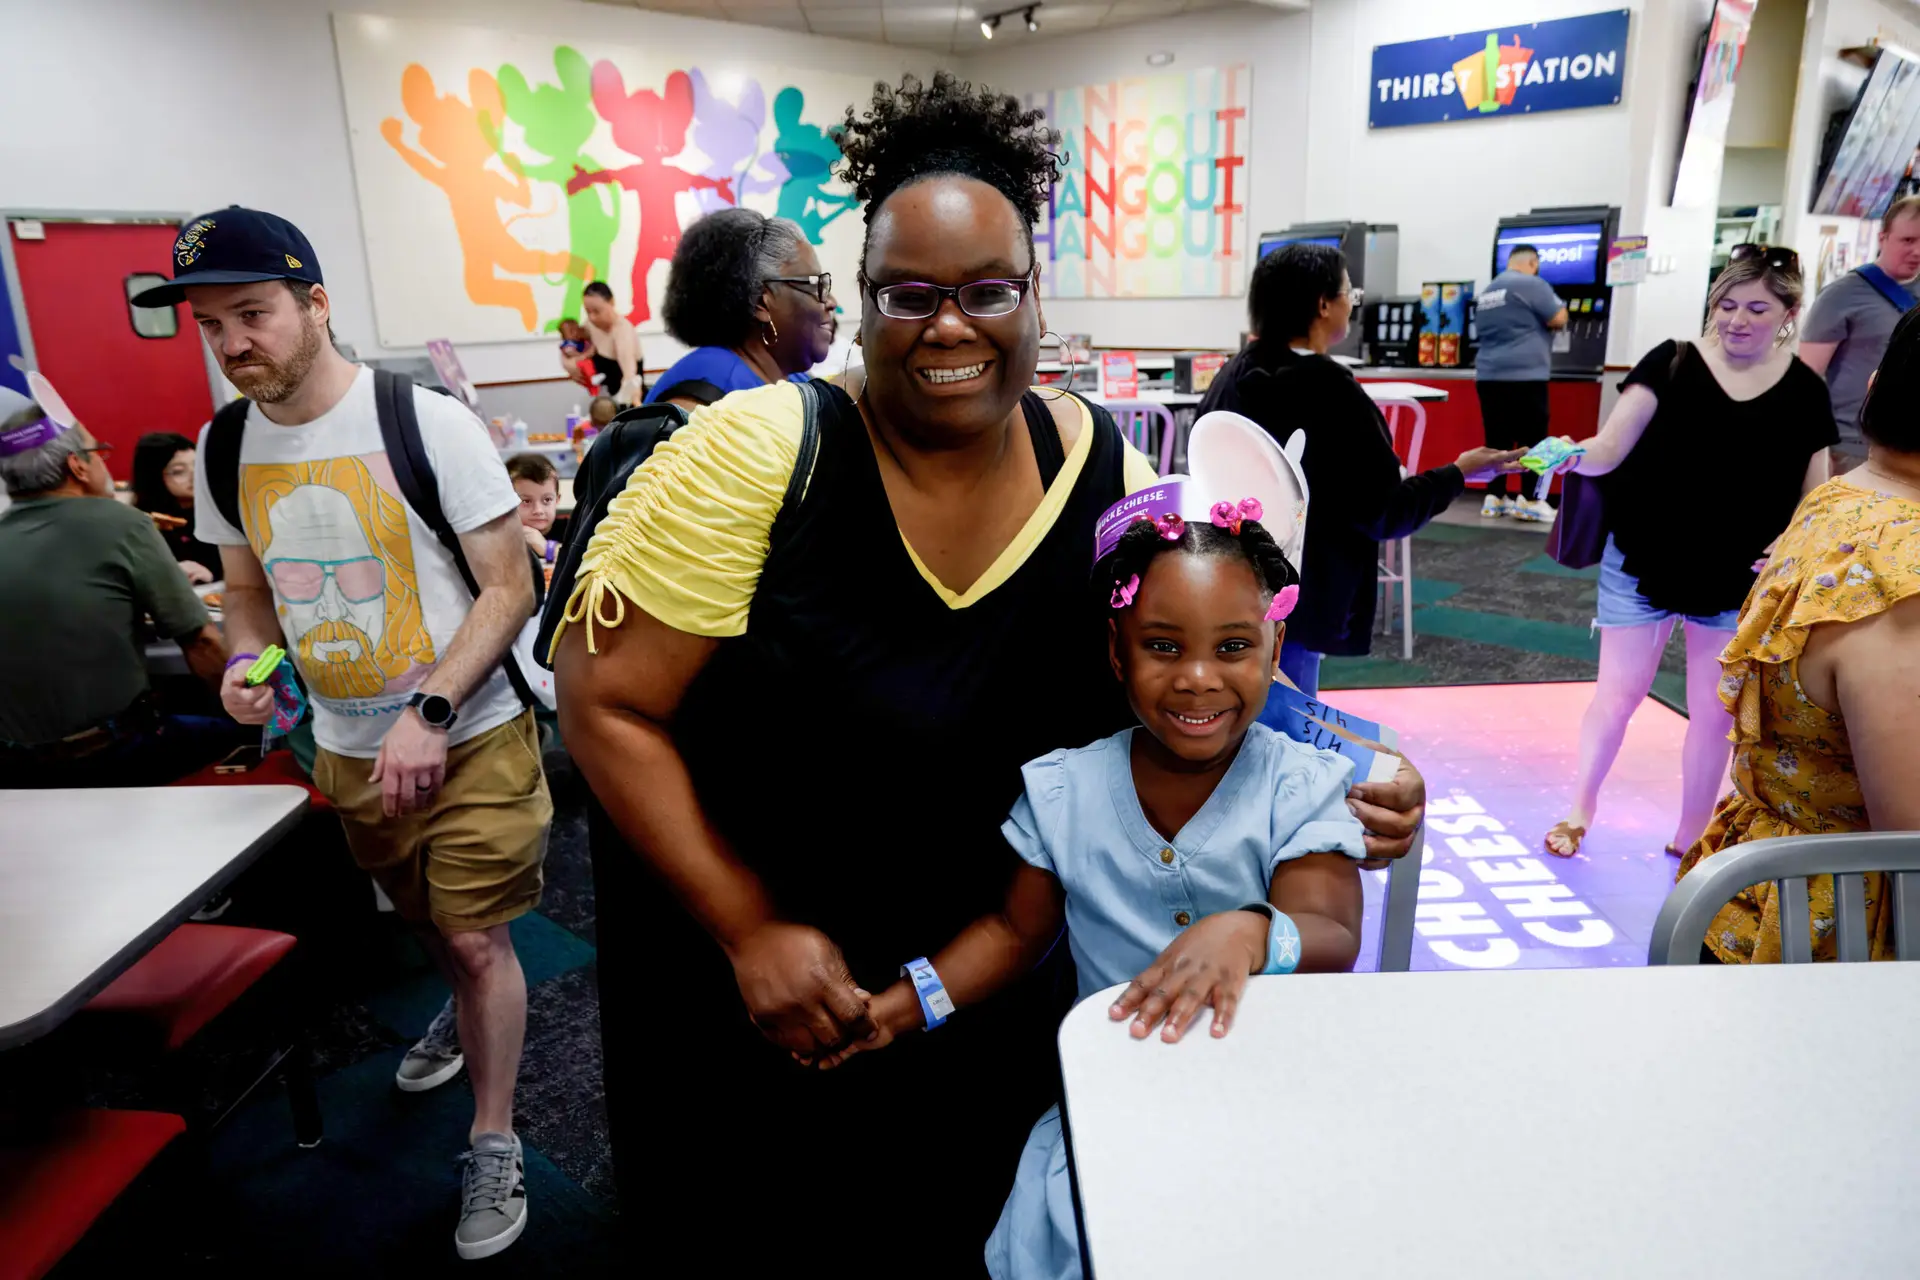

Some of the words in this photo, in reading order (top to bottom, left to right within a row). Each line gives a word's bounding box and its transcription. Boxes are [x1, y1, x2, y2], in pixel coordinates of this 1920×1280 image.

[1377, 69, 1473, 103] THIRST
[1495, 50, 1617, 89] STATION
[1424, 794, 1615, 948] CHEESE
